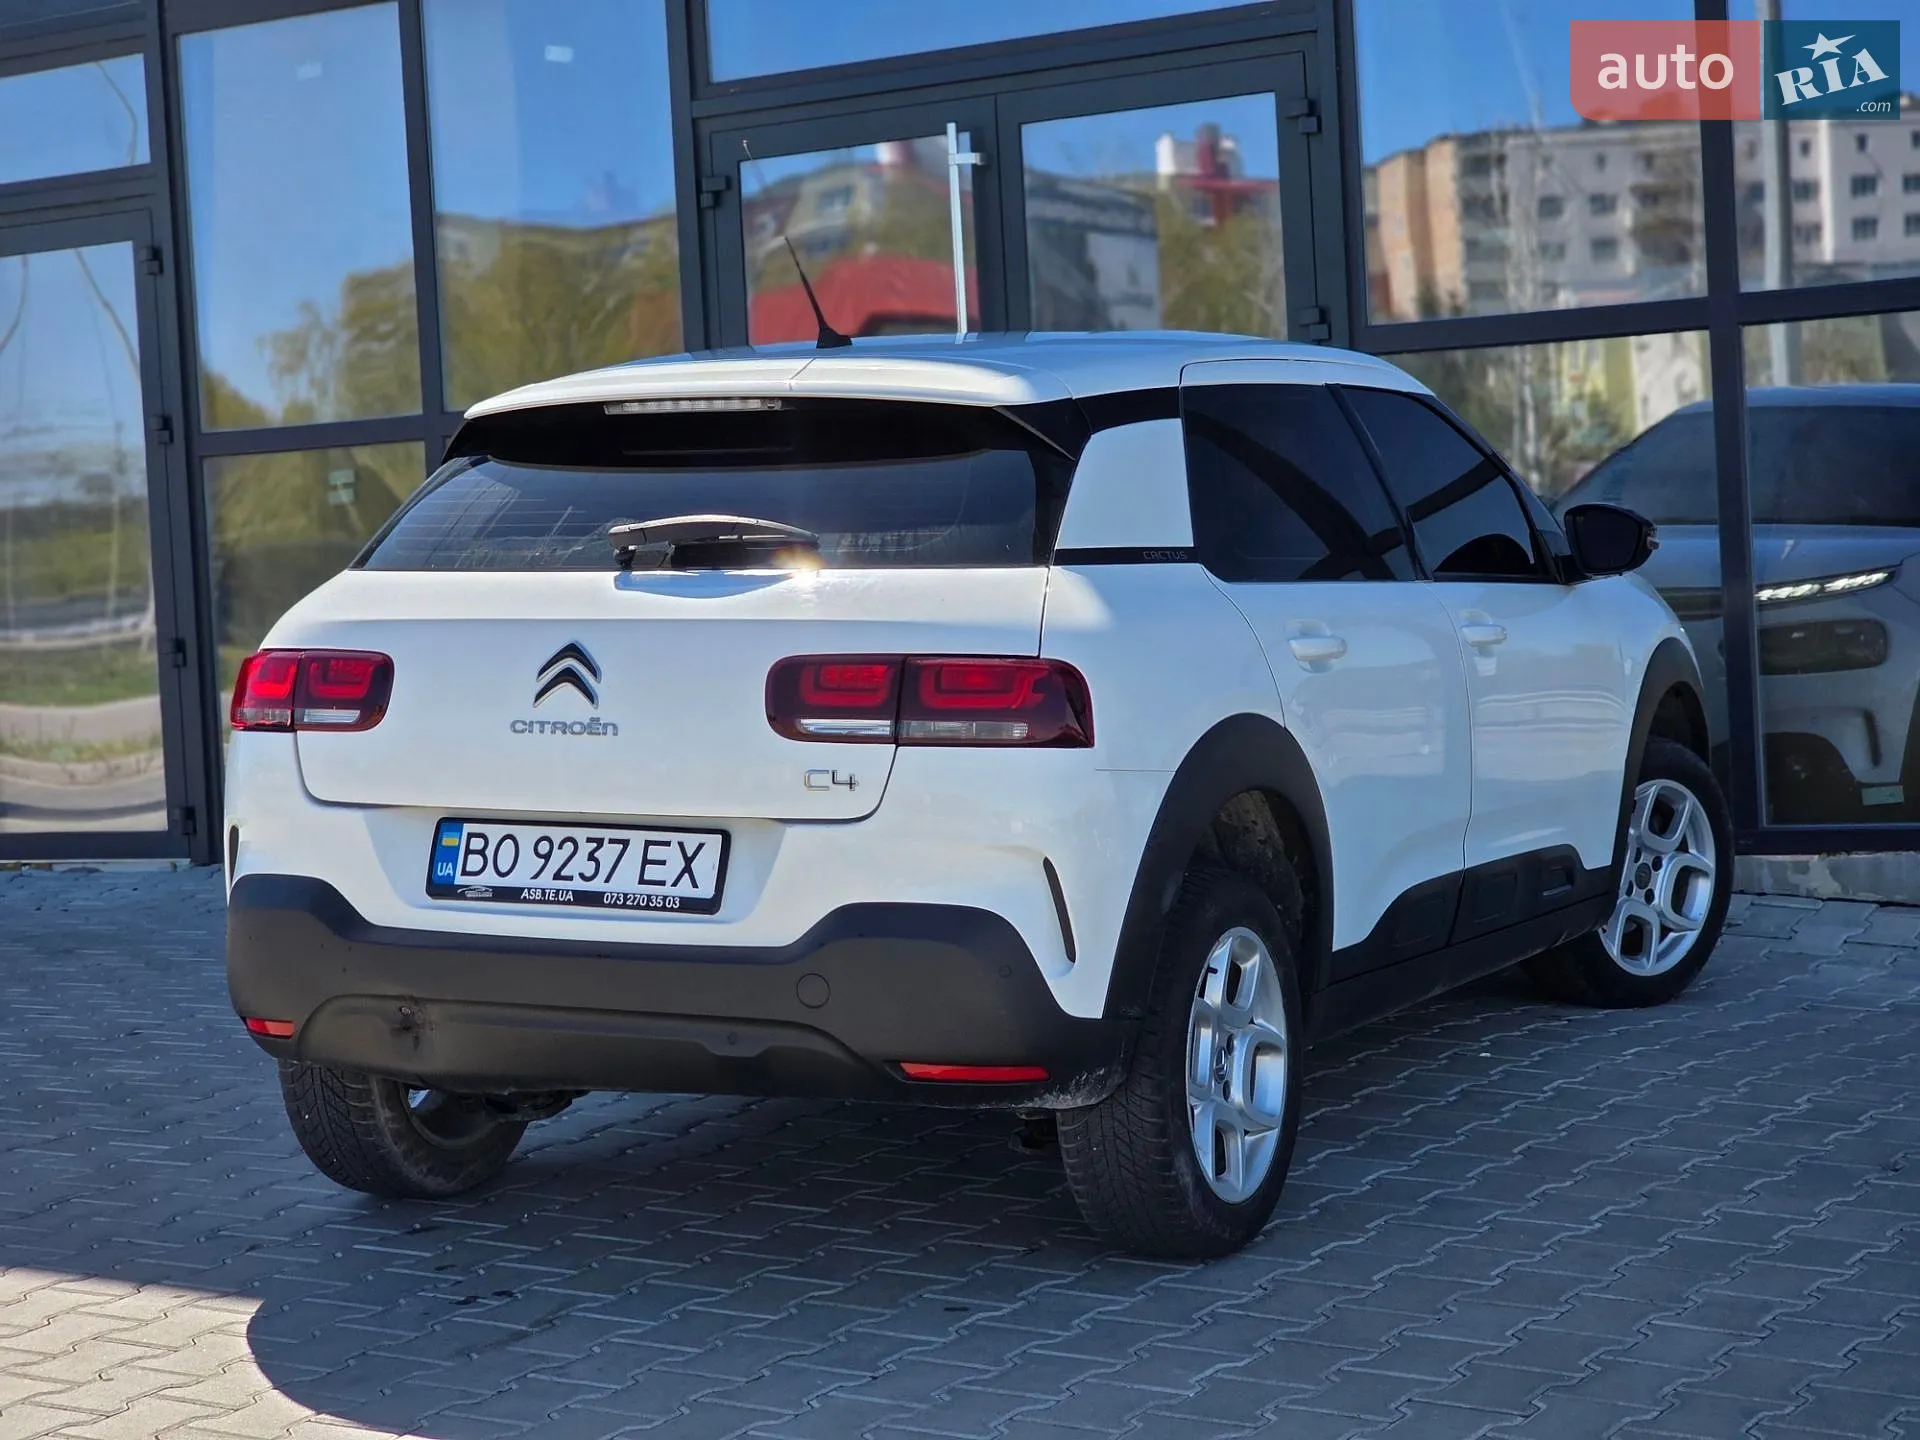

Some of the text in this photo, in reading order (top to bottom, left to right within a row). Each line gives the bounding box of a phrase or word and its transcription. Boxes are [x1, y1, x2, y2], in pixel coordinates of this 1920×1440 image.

[1143, 551, 1187, 560] CACTUS
[803, 769, 859, 792] C4
[460, 832, 706, 889] BO 9237 EX
[437, 862, 454, 877] UA
[520, 888, 574, 902] ASB.TE.UA
[603, 892, 680, 908] 073 270 35 03
